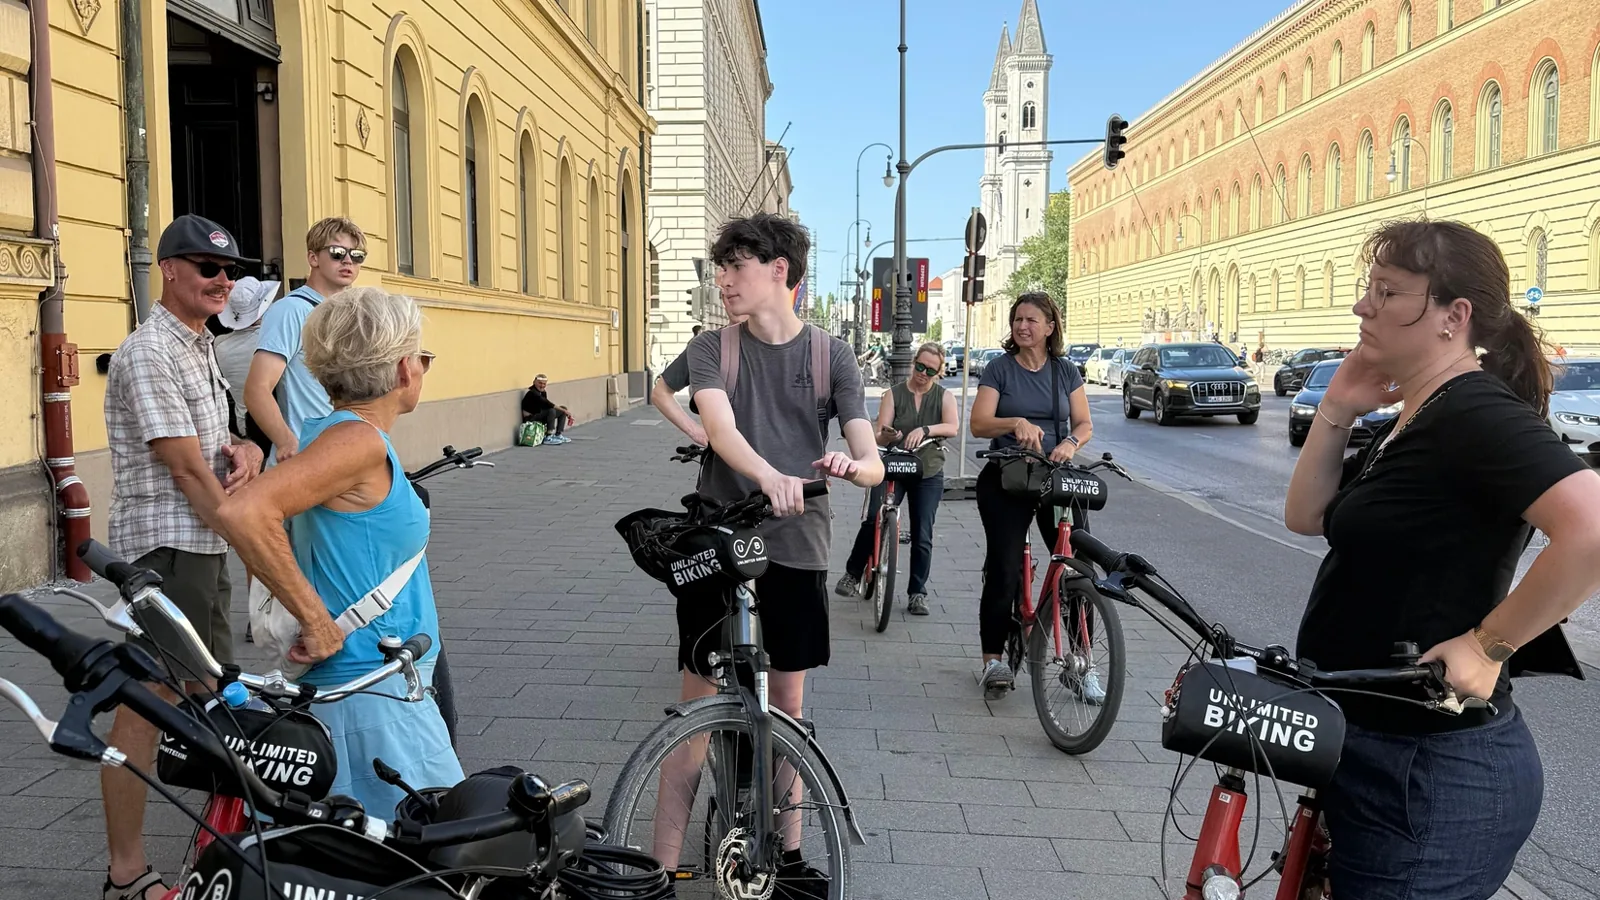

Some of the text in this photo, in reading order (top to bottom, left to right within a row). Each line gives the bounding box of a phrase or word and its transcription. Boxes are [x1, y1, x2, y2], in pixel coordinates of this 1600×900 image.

[1061, 482, 1100, 495] BIKING
[737, 541, 761, 553] U B
[670, 548, 716, 572] UNLIMITED
[673, 559, 722, 586] BIKING
[1208, 687, 1319, 729] UNLIMITED
[1203, 703, 1316, 752] BIKING
